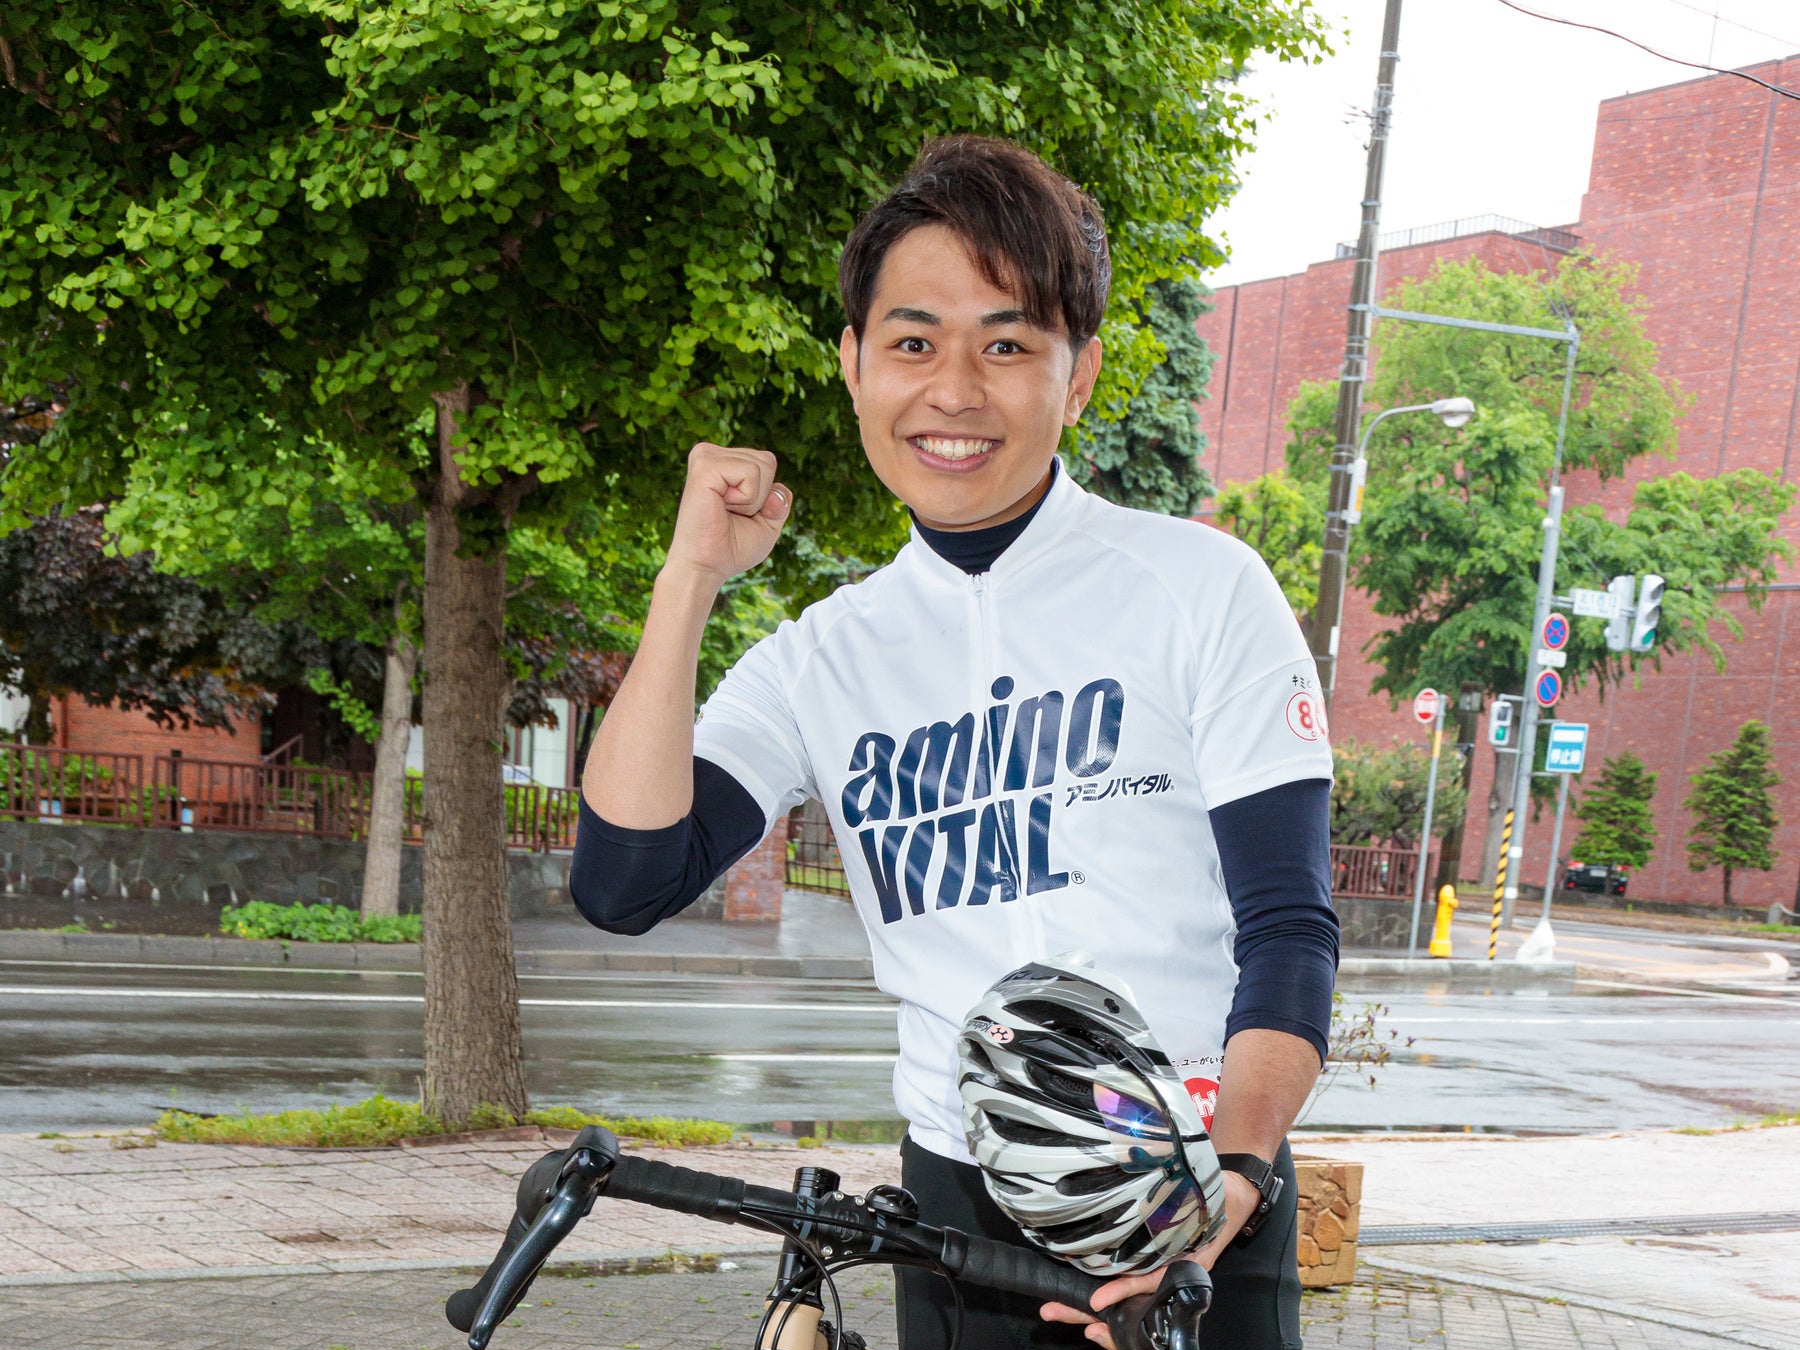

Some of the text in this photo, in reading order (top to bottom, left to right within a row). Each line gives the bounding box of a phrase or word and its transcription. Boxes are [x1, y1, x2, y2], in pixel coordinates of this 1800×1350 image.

[842, 676, 1125, 828] amino
[1066, 774, 1172, 807] アミノバイタル
[859, 793, 1069, 924] VITAL
